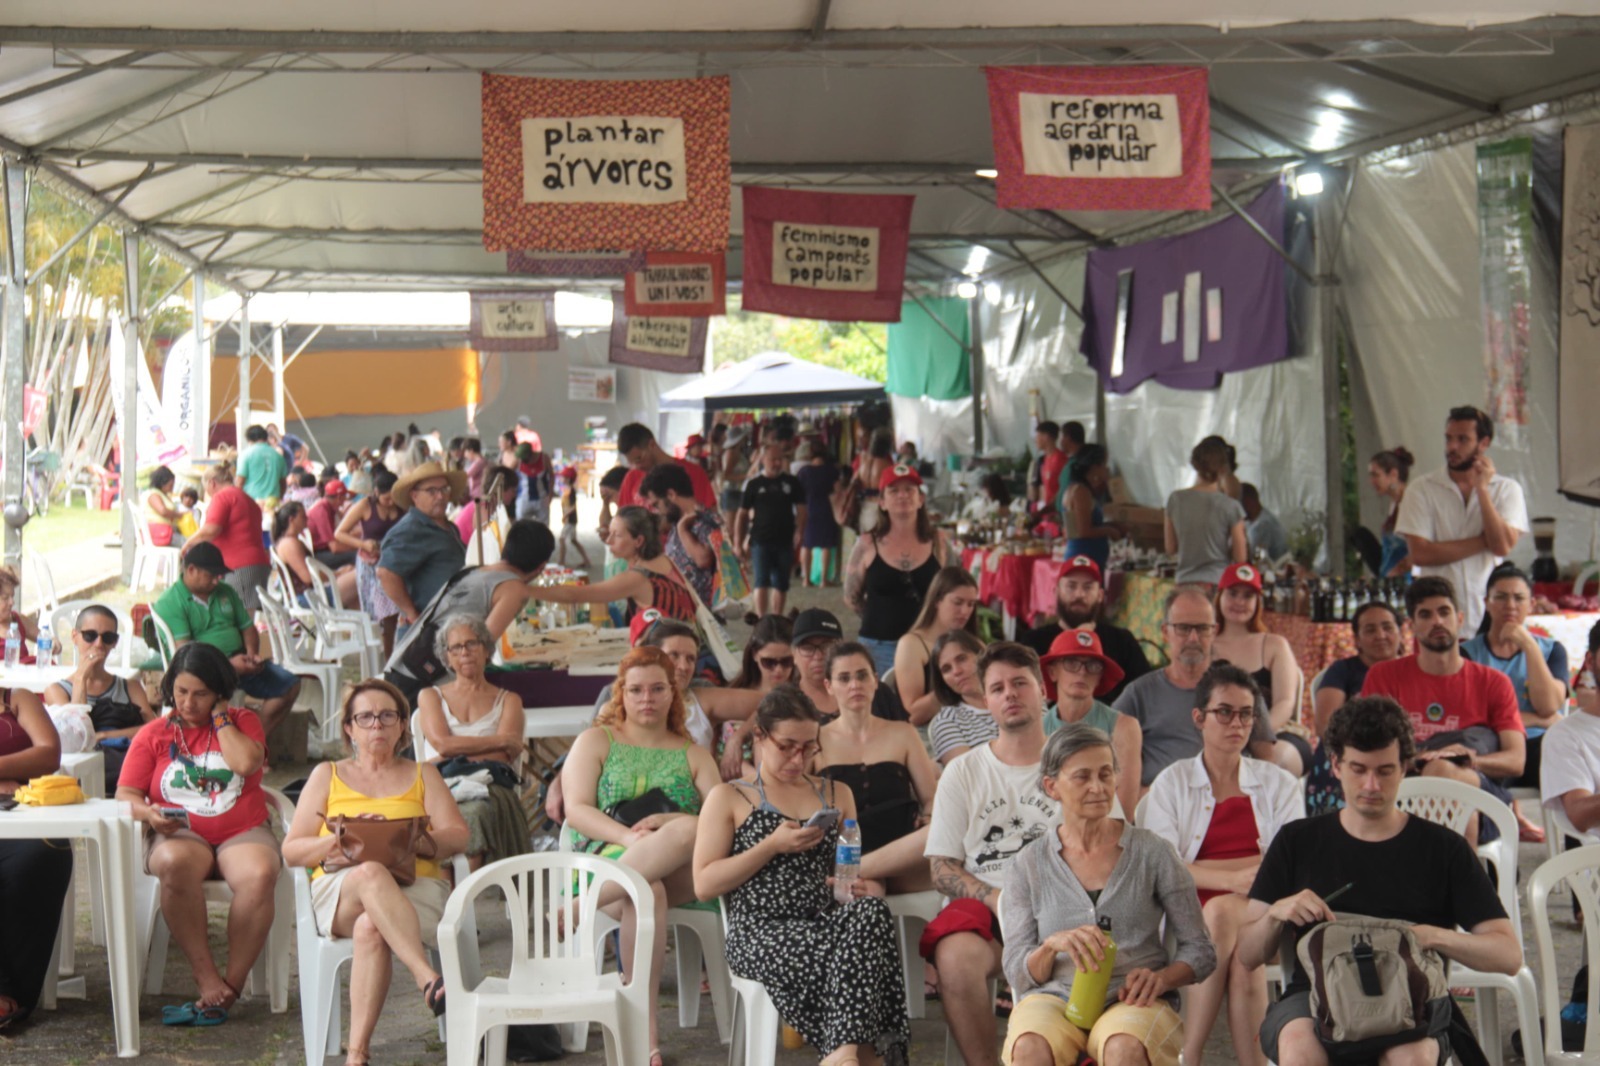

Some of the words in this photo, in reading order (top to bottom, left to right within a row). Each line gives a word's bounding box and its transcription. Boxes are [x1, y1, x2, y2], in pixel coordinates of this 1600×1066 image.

[1050, 98, 1164, 121] reforma
[543, 118, 665, 156] plantar
[1068, 140, 1157, 172] popular
[542, 153, 674, 191] árvores
[781, 225, 870, 248] feminismo
[784, 246, 870, 268] camponês
[789, 265, 864, 286] popular
[979, 797, 1007, 820] LEIA
